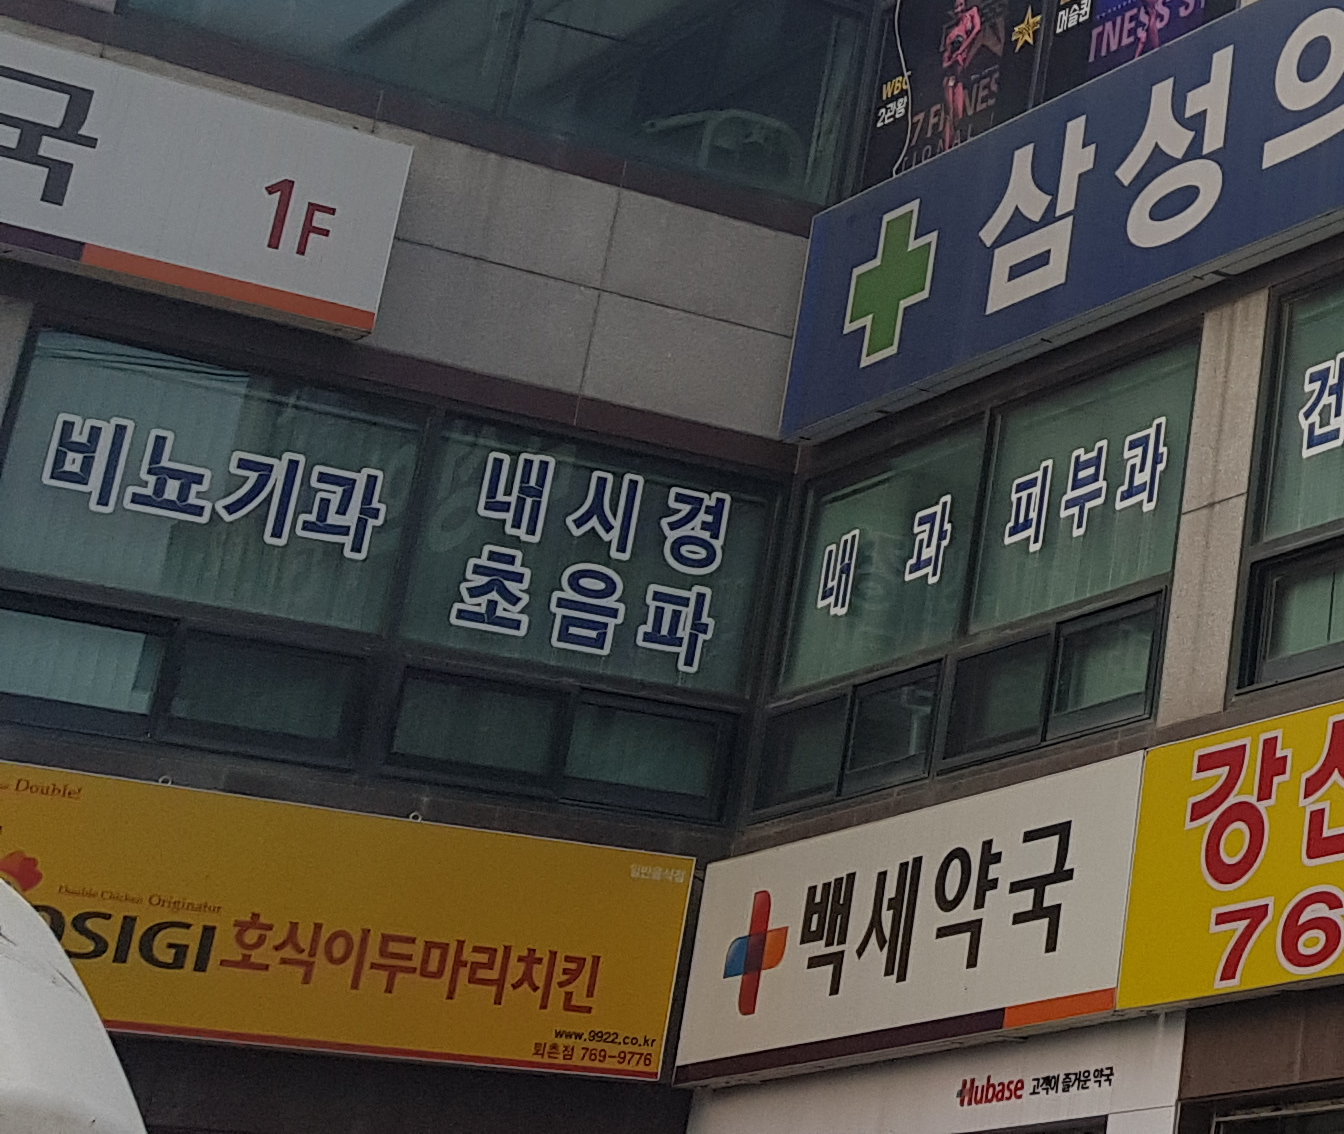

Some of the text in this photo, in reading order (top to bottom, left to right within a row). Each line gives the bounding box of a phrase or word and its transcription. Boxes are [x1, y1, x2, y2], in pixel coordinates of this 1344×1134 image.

[0, 69, 98, 206] 국
[876, 96, 907, 128] 2관왕
[264, 178, 337, 256] 1F
[41, 413, 386, 561] 비뇨기과
[477, 451, 731, 575] 내시경
[1004, 415, 1168, 553] 피부과
[449, 545, 715, 674] 초음파
[219, 913, 602, 1015] 호식이두마리치킨
[800, 819, 1075, 997] 백세약국
[532, 1042, 652, 1067] 퇴촌점 769-9776
[957, 1075, 1025, 1107] Hubase
[1029, 1073, 1060, 1096] 고객이
[1093, 1066, 1115, 1088] 약국
